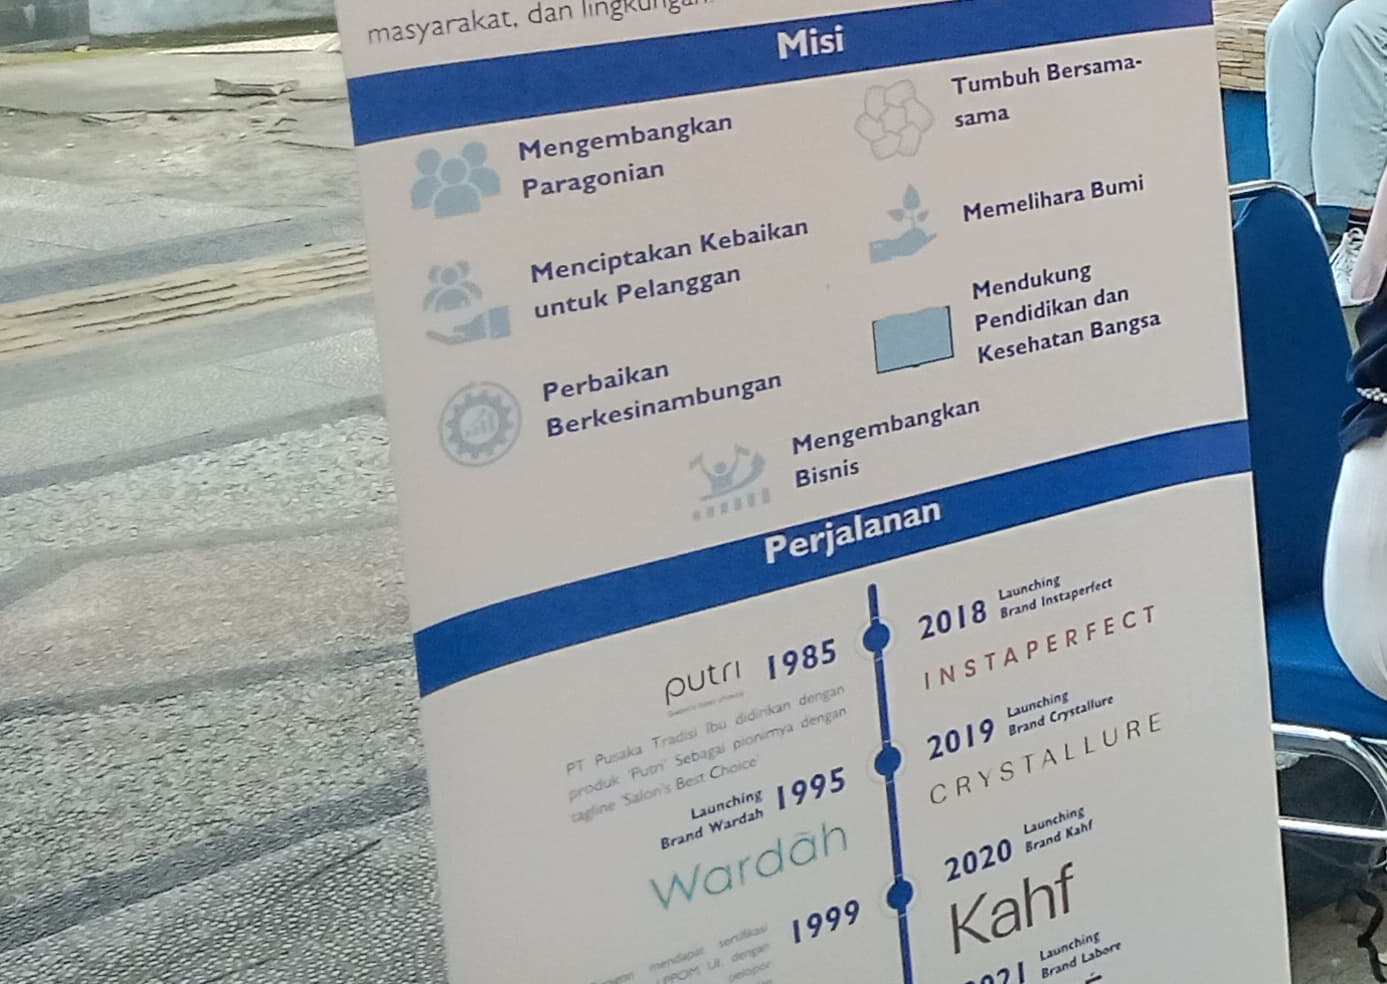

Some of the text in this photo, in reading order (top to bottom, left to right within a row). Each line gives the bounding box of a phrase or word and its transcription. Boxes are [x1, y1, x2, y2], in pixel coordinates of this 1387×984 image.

[528, 1, 573, 23] dan
[777, 24, 843, 59] Misi
[951, 58, 1142, 94] Tumbuh Bersama-
[955, 108, 1010, 127] sama
[519, 117, 732, 161] Mengembangkan
[522, 163, 664, 198] Paragonian
[963, 174, 1143, 222] Memelihara Bumi
[531, 222, 808, 283] Menciptakan Kebaikan
[535, 269, 740, 318] untuk Pelanggan
[973, 265, 1091, 300] Mendukung
[976, 288, 1128, 331] Pendidikan dan
[978, 314, 1161, 363] Kesehatan Bangsa
[543, 365, 668, 402] Perbaikan
[547, 376, 781, 437] Berkesinambungan
[792, 401, 980, 455] Mengembangkan
[796, 459, 859, 488] Bisnis
[765, 503, 940, 563] Perjalanan
[998, 576, 1060, 600] Launching
[1000, 578, 1112, 619] Brand Instaperfect
[918, 600, 986, 640] 2018
[768, 638, 836, 680] 1985
[925, 605, 1154, 690] INSTAPERFECT
[799, 685, 845, 706] dengan
[1007, 692, 1069, 718] Launching
[800, 707, 847, 728] dengan
[1009, 696, 1113, 736] Brand Crystallure
[927, 719, 994, 760] 2019
[930, 713, 1160, 804] CRYSTALLURE
[675, 773, 706, 790] Best
[777, 767, 845, 810] 1995
[691, 790, 763, 820] Launching
[1024, 807, 1085, 835] Launching
[661, 808, 763, 850] Brand Wardah
[1026, 819, 1093, 853] Brand Kahf
[944, 839, 1011, 882] 2020
[793, 900, 859, 944] 1999
[951, 862, 1073, 954] Kahf
[1040, 932, 1100, 961] Launching
[1042, 956, 1077, 979] Brand
